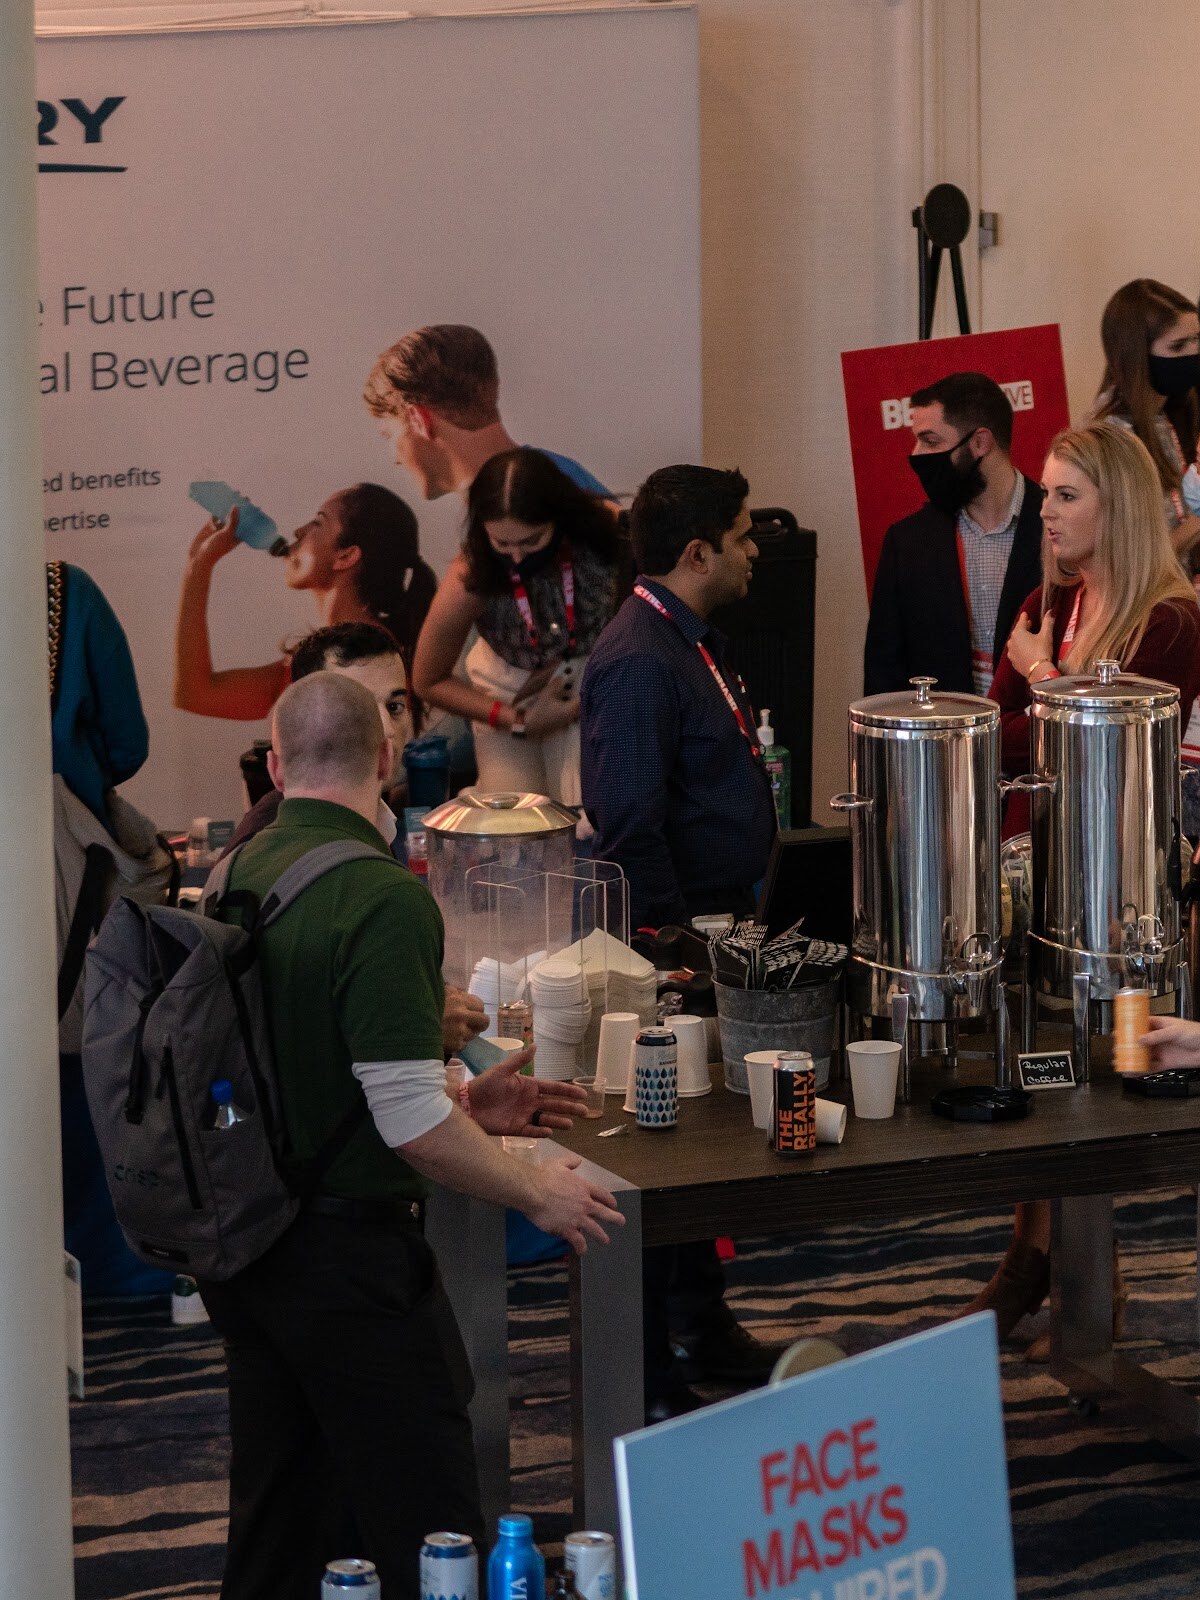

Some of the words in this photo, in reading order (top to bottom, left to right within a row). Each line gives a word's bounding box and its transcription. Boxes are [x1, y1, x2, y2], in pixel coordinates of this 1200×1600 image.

[63, 286, 215, 326] Future
[91, 349, 309, 392] Beverage
[70, 467, 161, 492] benefits
[45, 511, 110, 532] ertise
[779, 1109, 793, 1150] THE
[793, 1071, 808, 1151] REALLY
[760, 1416, 881, 1516] FACE
[742, 1484, 909, 1599] MASKS
